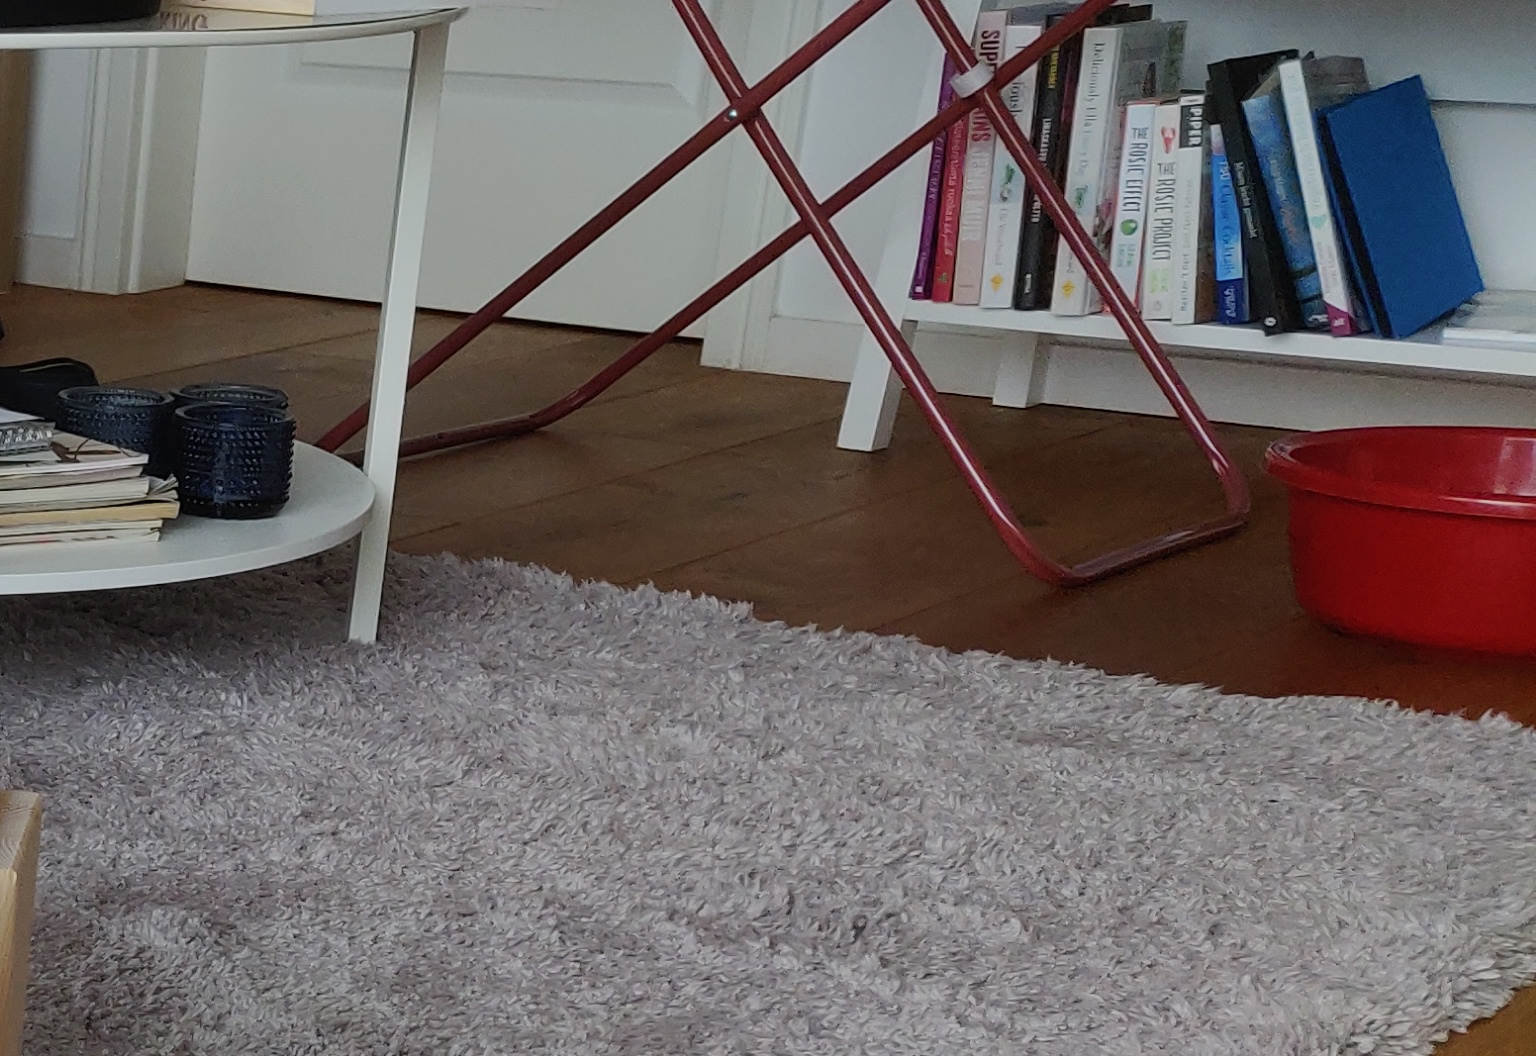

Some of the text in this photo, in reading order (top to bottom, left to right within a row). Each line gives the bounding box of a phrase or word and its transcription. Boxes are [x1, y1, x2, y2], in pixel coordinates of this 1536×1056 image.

[1087, 43, 1106, 101] Deliciously
[1188, 106, 1203, 146] PIPER
[1122, 127, 1149, 212] THE ROSIE EFFECT
[1157, 162, 1176, 175] THE
[1154, 179, 1176, 214] ROSIE
[1152, 217, 1174, 261] PROJECT
